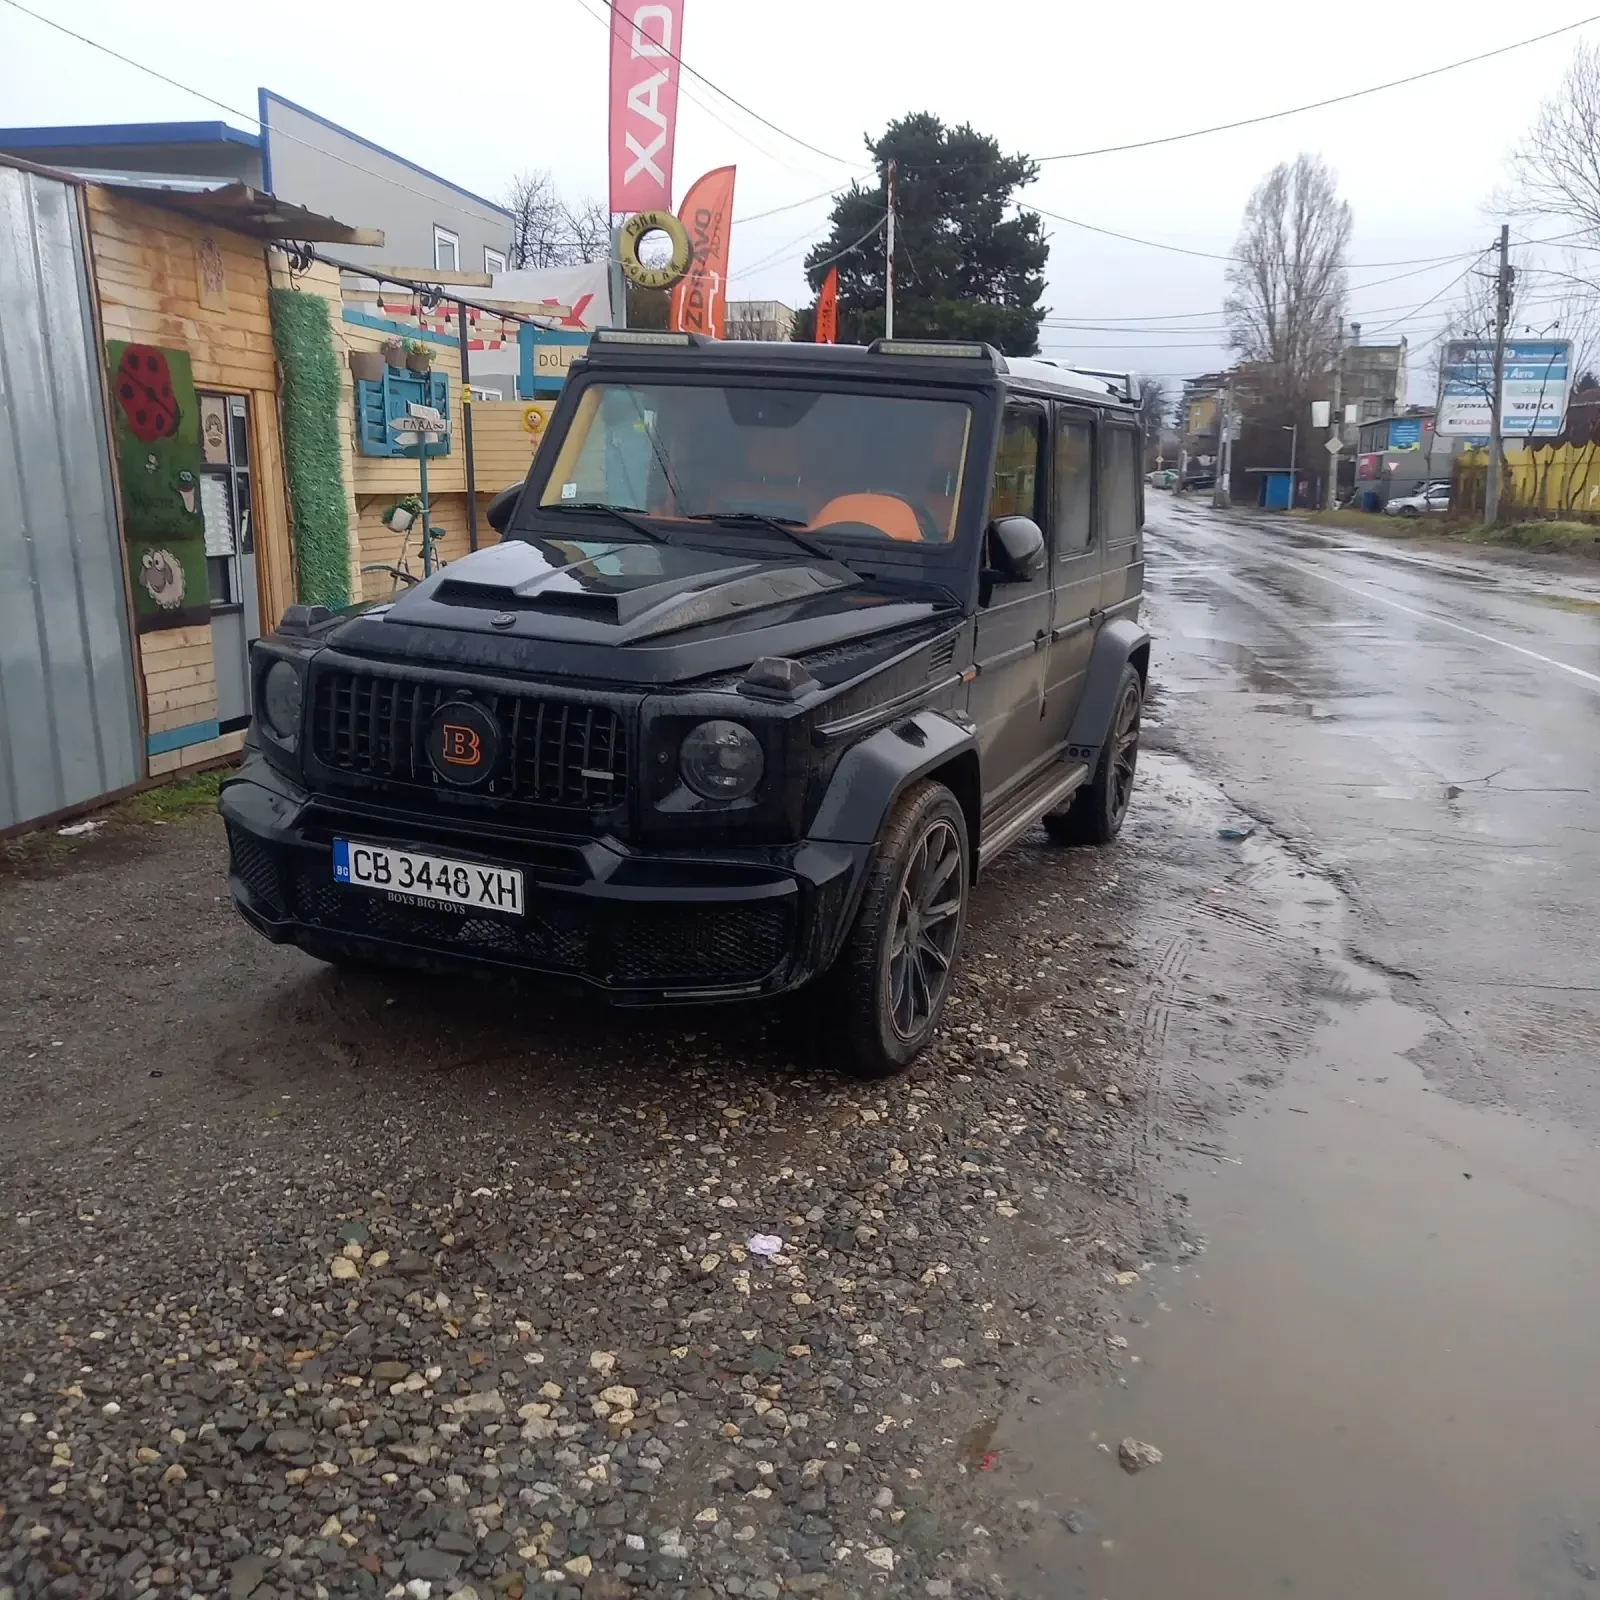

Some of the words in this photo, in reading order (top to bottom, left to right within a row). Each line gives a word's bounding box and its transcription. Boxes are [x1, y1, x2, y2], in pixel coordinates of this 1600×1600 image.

[624, 5, 672, 188] XAD
[686, 209, 711, 329] ZDRAVO
[443, 724, 480, 765] B
[336, 865, 348, 876] BG
[354, 850, 391, 884] CB
[398, 857, 471, 899] 3448
[476, 869, 517, 908] XH
[387, 891, 415, 907] BOYS
[417, 897, 436, 910] BIG
[437, 901, 466, 915] TOYS
